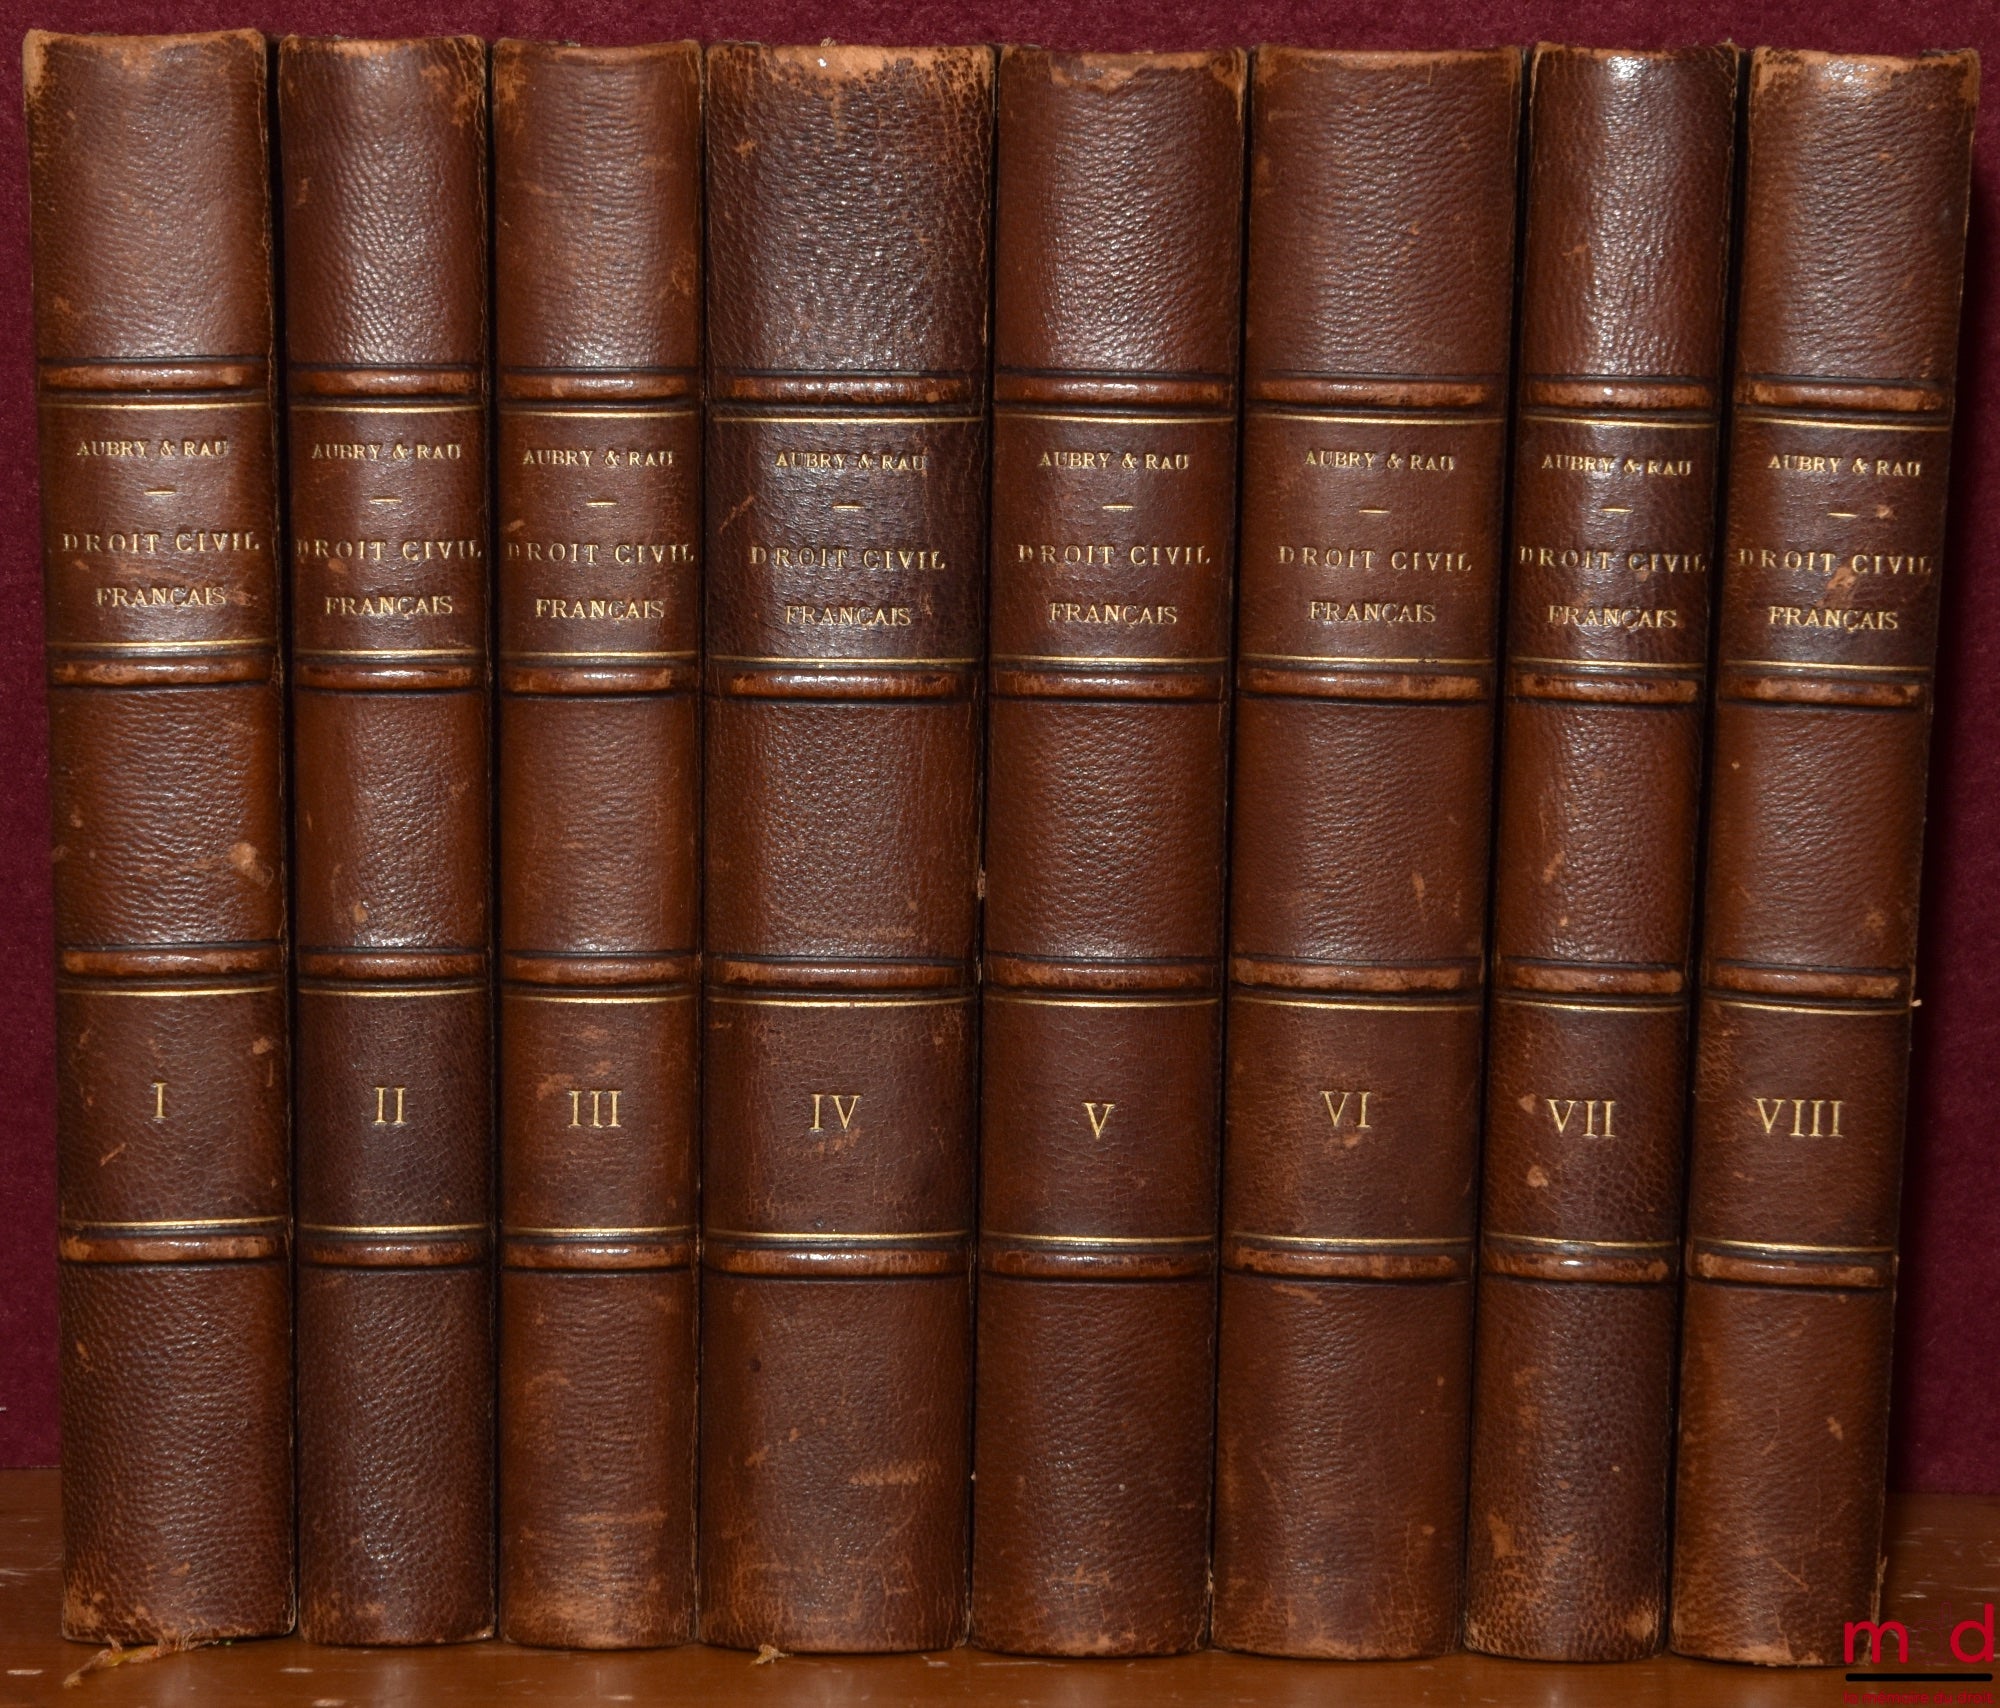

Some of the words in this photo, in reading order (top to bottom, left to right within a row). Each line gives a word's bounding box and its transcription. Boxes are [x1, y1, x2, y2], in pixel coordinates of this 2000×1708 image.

[76, 440, 149, 457] AUBRY
[159, 440, 175, 457] &
[183, 440, 229, 457] RAU
[311, 443, 383, 460] AUBRY
[393, 443, 408, 459] &
[416, 443, 461, 459] RAU
[522, 449, 594, 467] AUBRY
[604, 450, 620, 466] &
[628, 451, 673, 467] RAU
[1039, 452, 1111, 469] AUBRY
[1122, 453, 1137, 469] &
[1145, 454, 1190, 470] RAU
[1305, 450, 1375, 469] AUBRY
[1387, 453, 1402, 470] &
[1409, 454, 1455, 471] RAU
[775, 452, 847, 470] AUBRY
[858, 453, 873, 470] &
[881, 454, 926, 471] RAU
[1542, 454, 1614, 473] AUBRY
[1623, 459, 1640, 474] &
[1647, 459, 1693, 477] RAU
[1768, 454, 1843, 474] AUBRY
[1852, 457, 1868, 475] &
[1876, 459, 1921, 478] RAU
[62, 532, 160, 553] DROIT
[175, 531, 260, 551] CIVIL
[296, 539, 387, 560] DROIT
[402, 539, 482, 560] CIVIL
[507, 542, 599, 563] DROIT
[615, 543, 695, 564] CIVIL
[751, 546, 849, 569] DROIT
[863, 550, 946, 571] CIVIL
[1018, 545, 1114, 565] DROIT
[1130, 546, 1211, 565] CIVIL
[1278, 546, 1376, 569] DROIT
[1391, 551, 1472, 572] CIVIL
[1520, 546, 1613, 570] DROIT
[1628, 553, 1706, 573] CIVIL
[1739, 548, 1836, 571] DROIT
[1851, 554, 1932, 575] CIVIL
[325, 595, 453, 618] FRANÇAIS
[1050, 602, 1178, 629] FRANÇAIS
[1309, 600, 1436, 626] FRANÇAIS
[1548, 604, 1677, 629] FRANÇAIS
[1768, 606, 1898, 633] FRANÇAIS
[151, 1081, 168, 1120] I
[374, 1086, 406, 1125] II
[569, 1089, 622, 1128] III
[808, 1093, 861, 1132] IV
[1319, 1090, 1372, 1129] VI
[1081, 1101, 1115, 1140] V
[1546, 1098, 1617, 1138] VII
[1754, 1097, 1844, 1138] VIII
